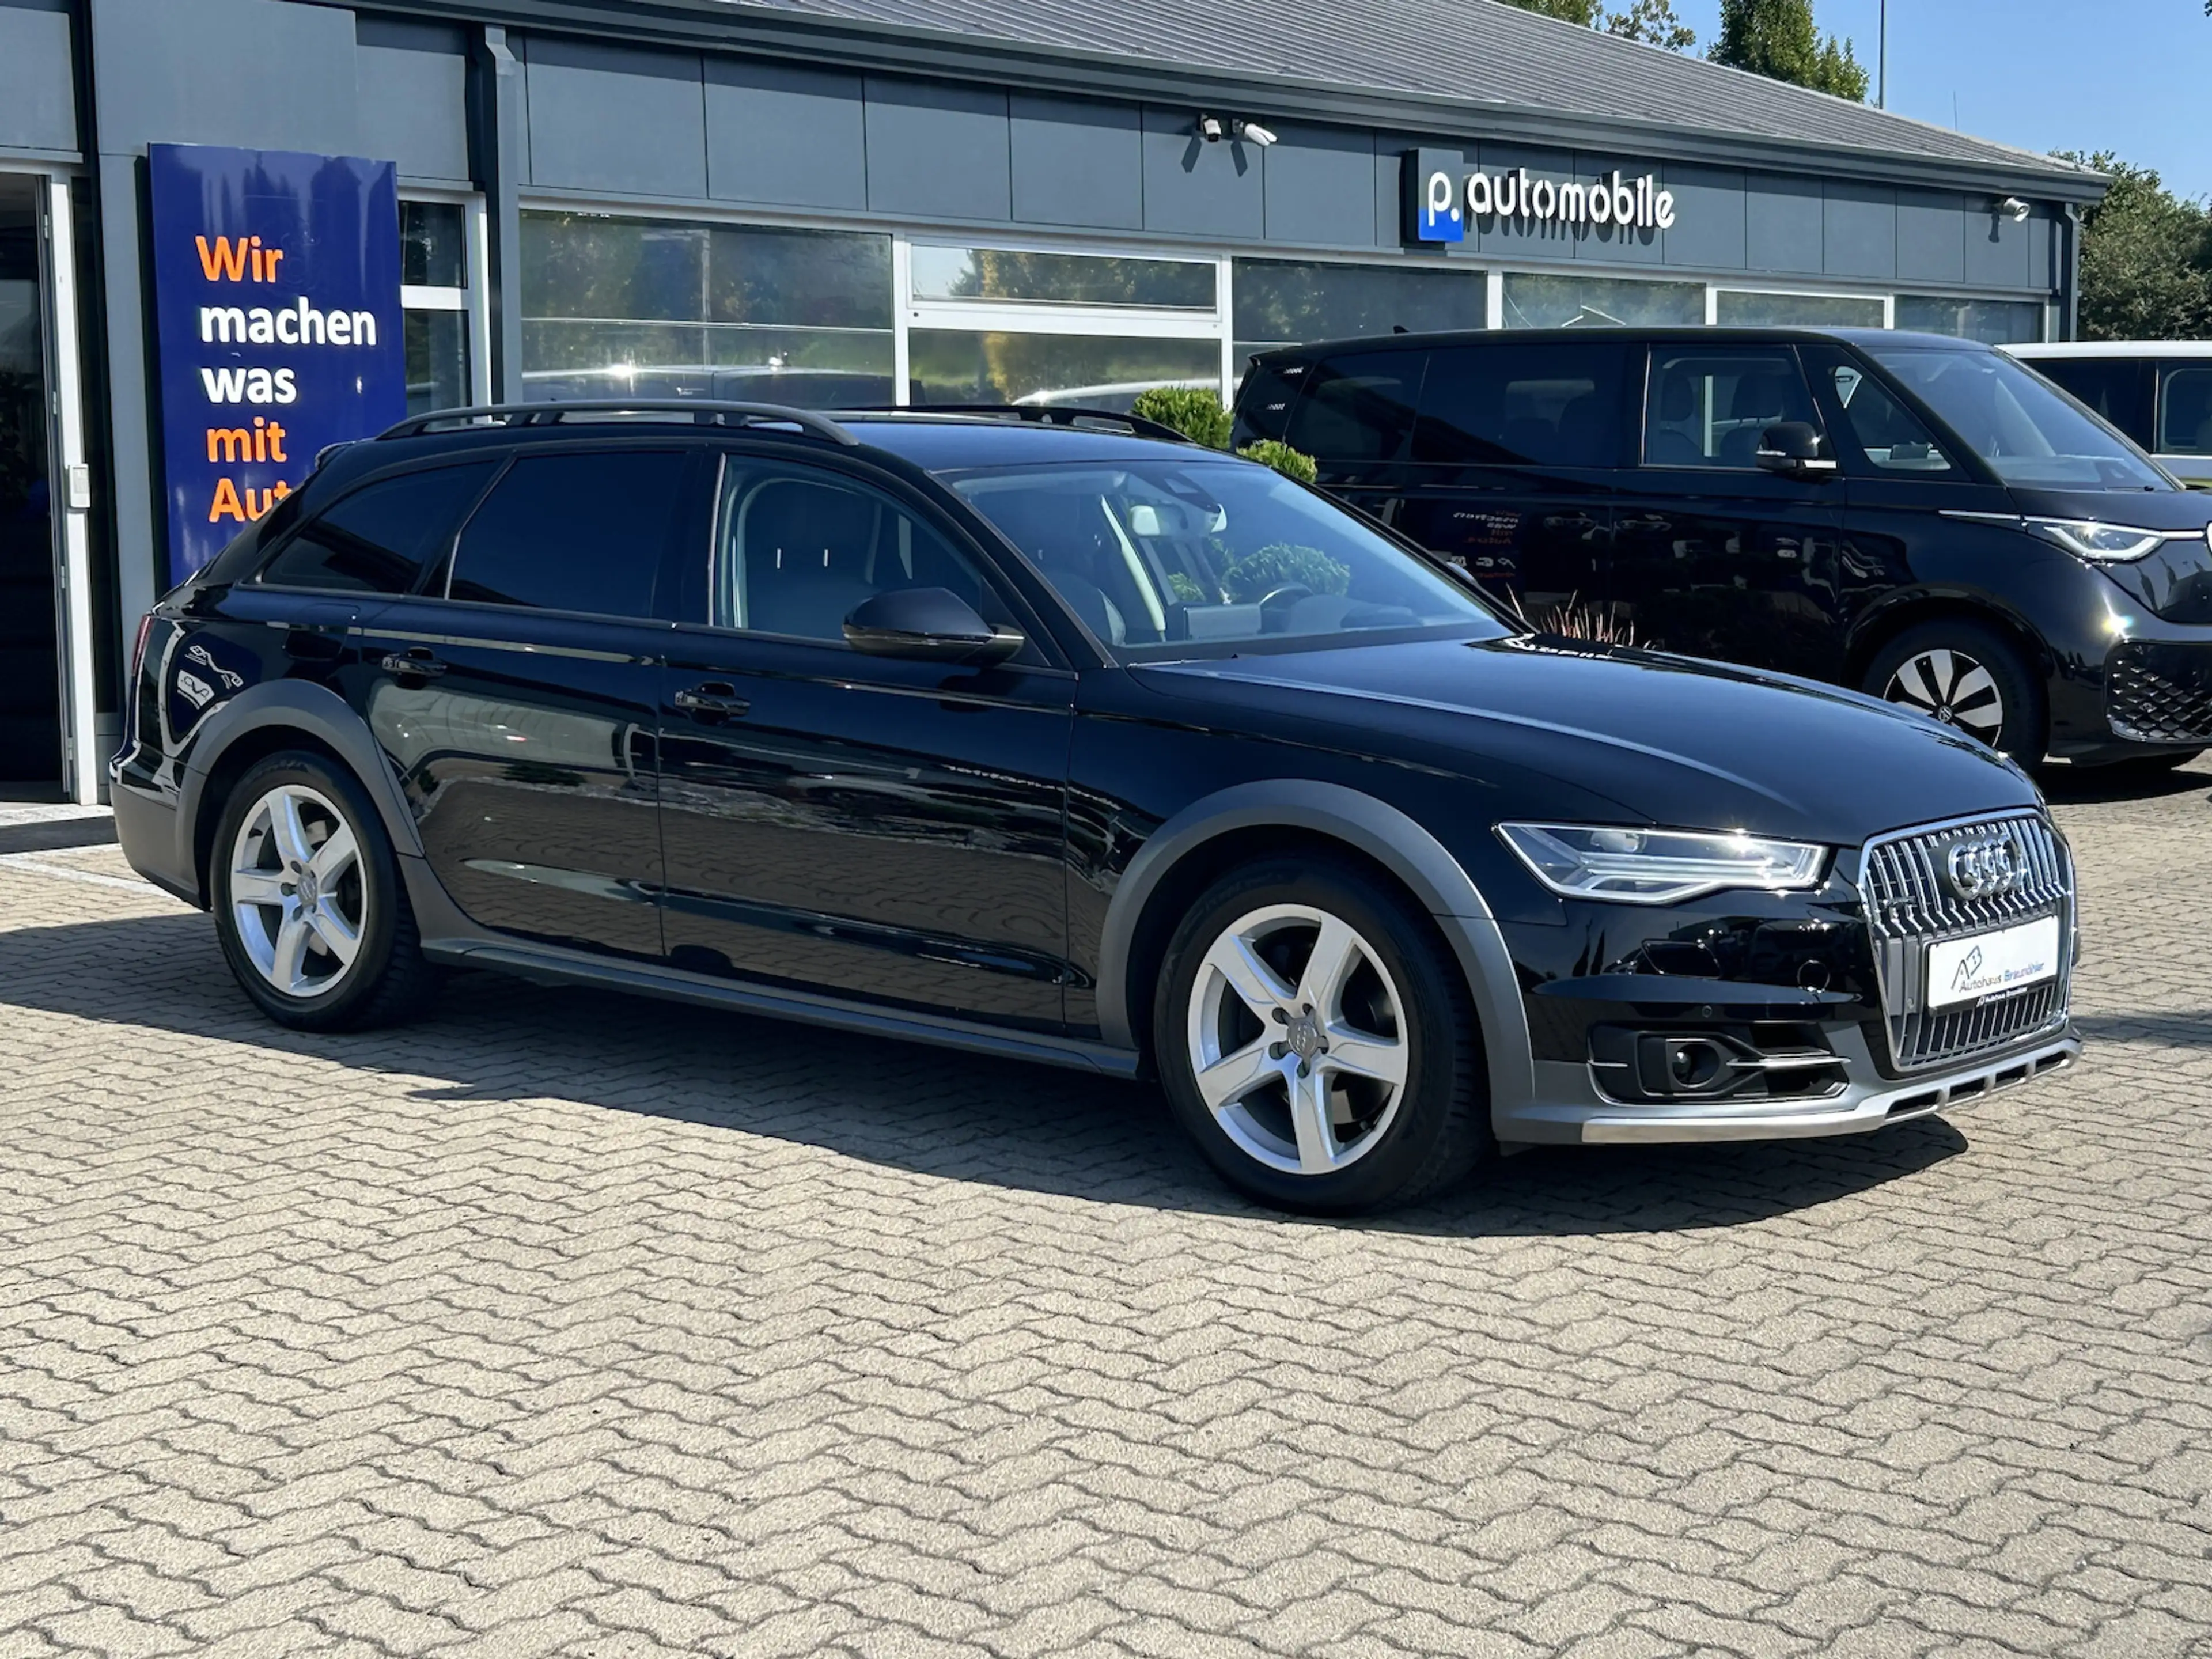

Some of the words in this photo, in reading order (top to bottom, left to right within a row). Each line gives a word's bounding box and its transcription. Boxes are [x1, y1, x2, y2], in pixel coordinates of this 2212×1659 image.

[1467, 167, 1675, 229] automobile
[195, 235, 283, 283] Wir
[200, 296, 377, 346] machen
[201, 366, 297, 404] was
[207, 417, 287, 463] mit
